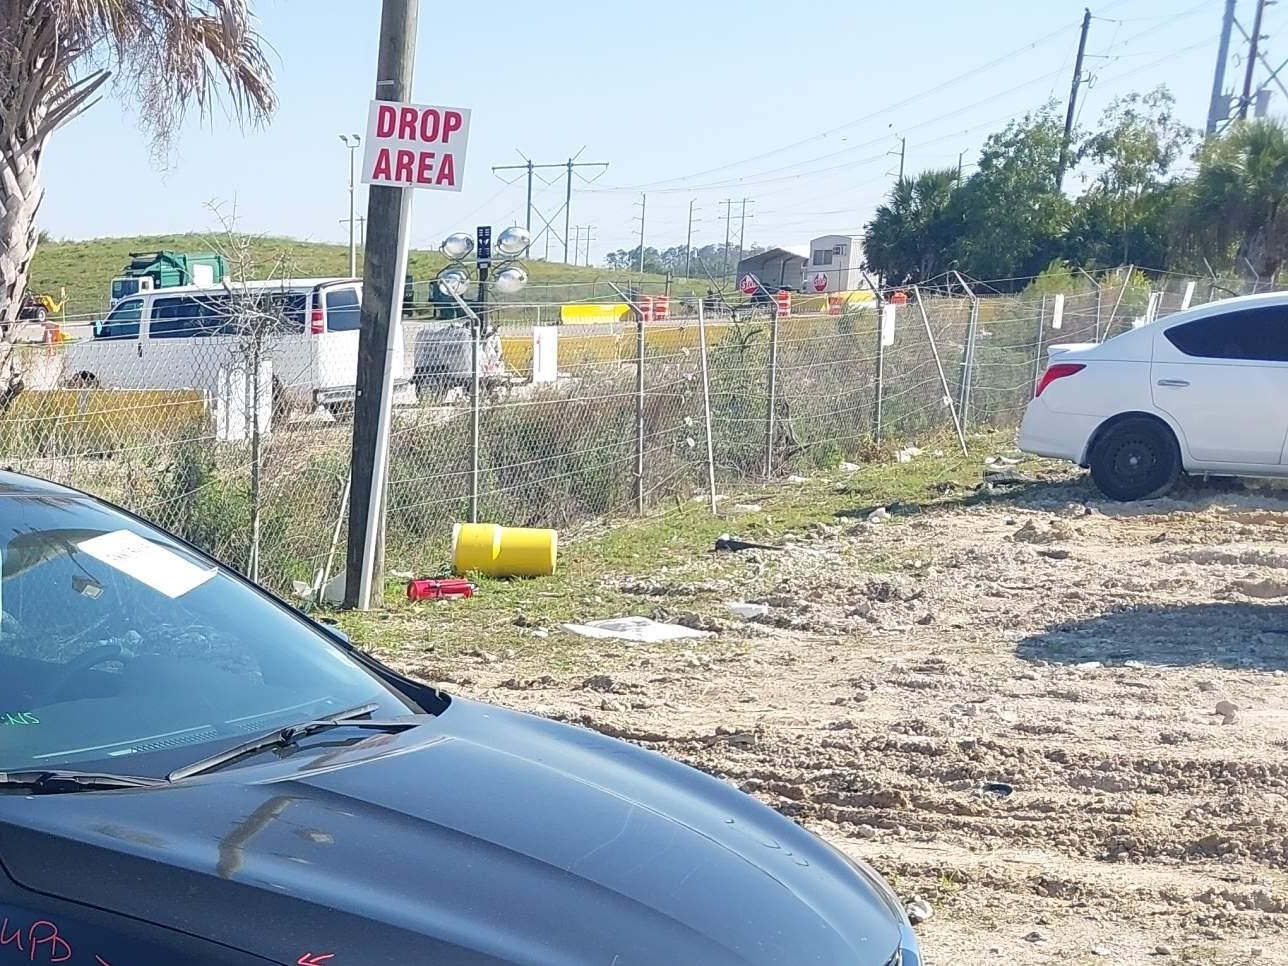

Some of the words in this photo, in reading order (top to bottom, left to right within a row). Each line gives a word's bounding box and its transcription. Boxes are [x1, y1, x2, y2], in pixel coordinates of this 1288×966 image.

[376, 105, 462, 143] DROP
[372, 148, 455, 186] AREA
[0, 917, 72, 962] UPD
